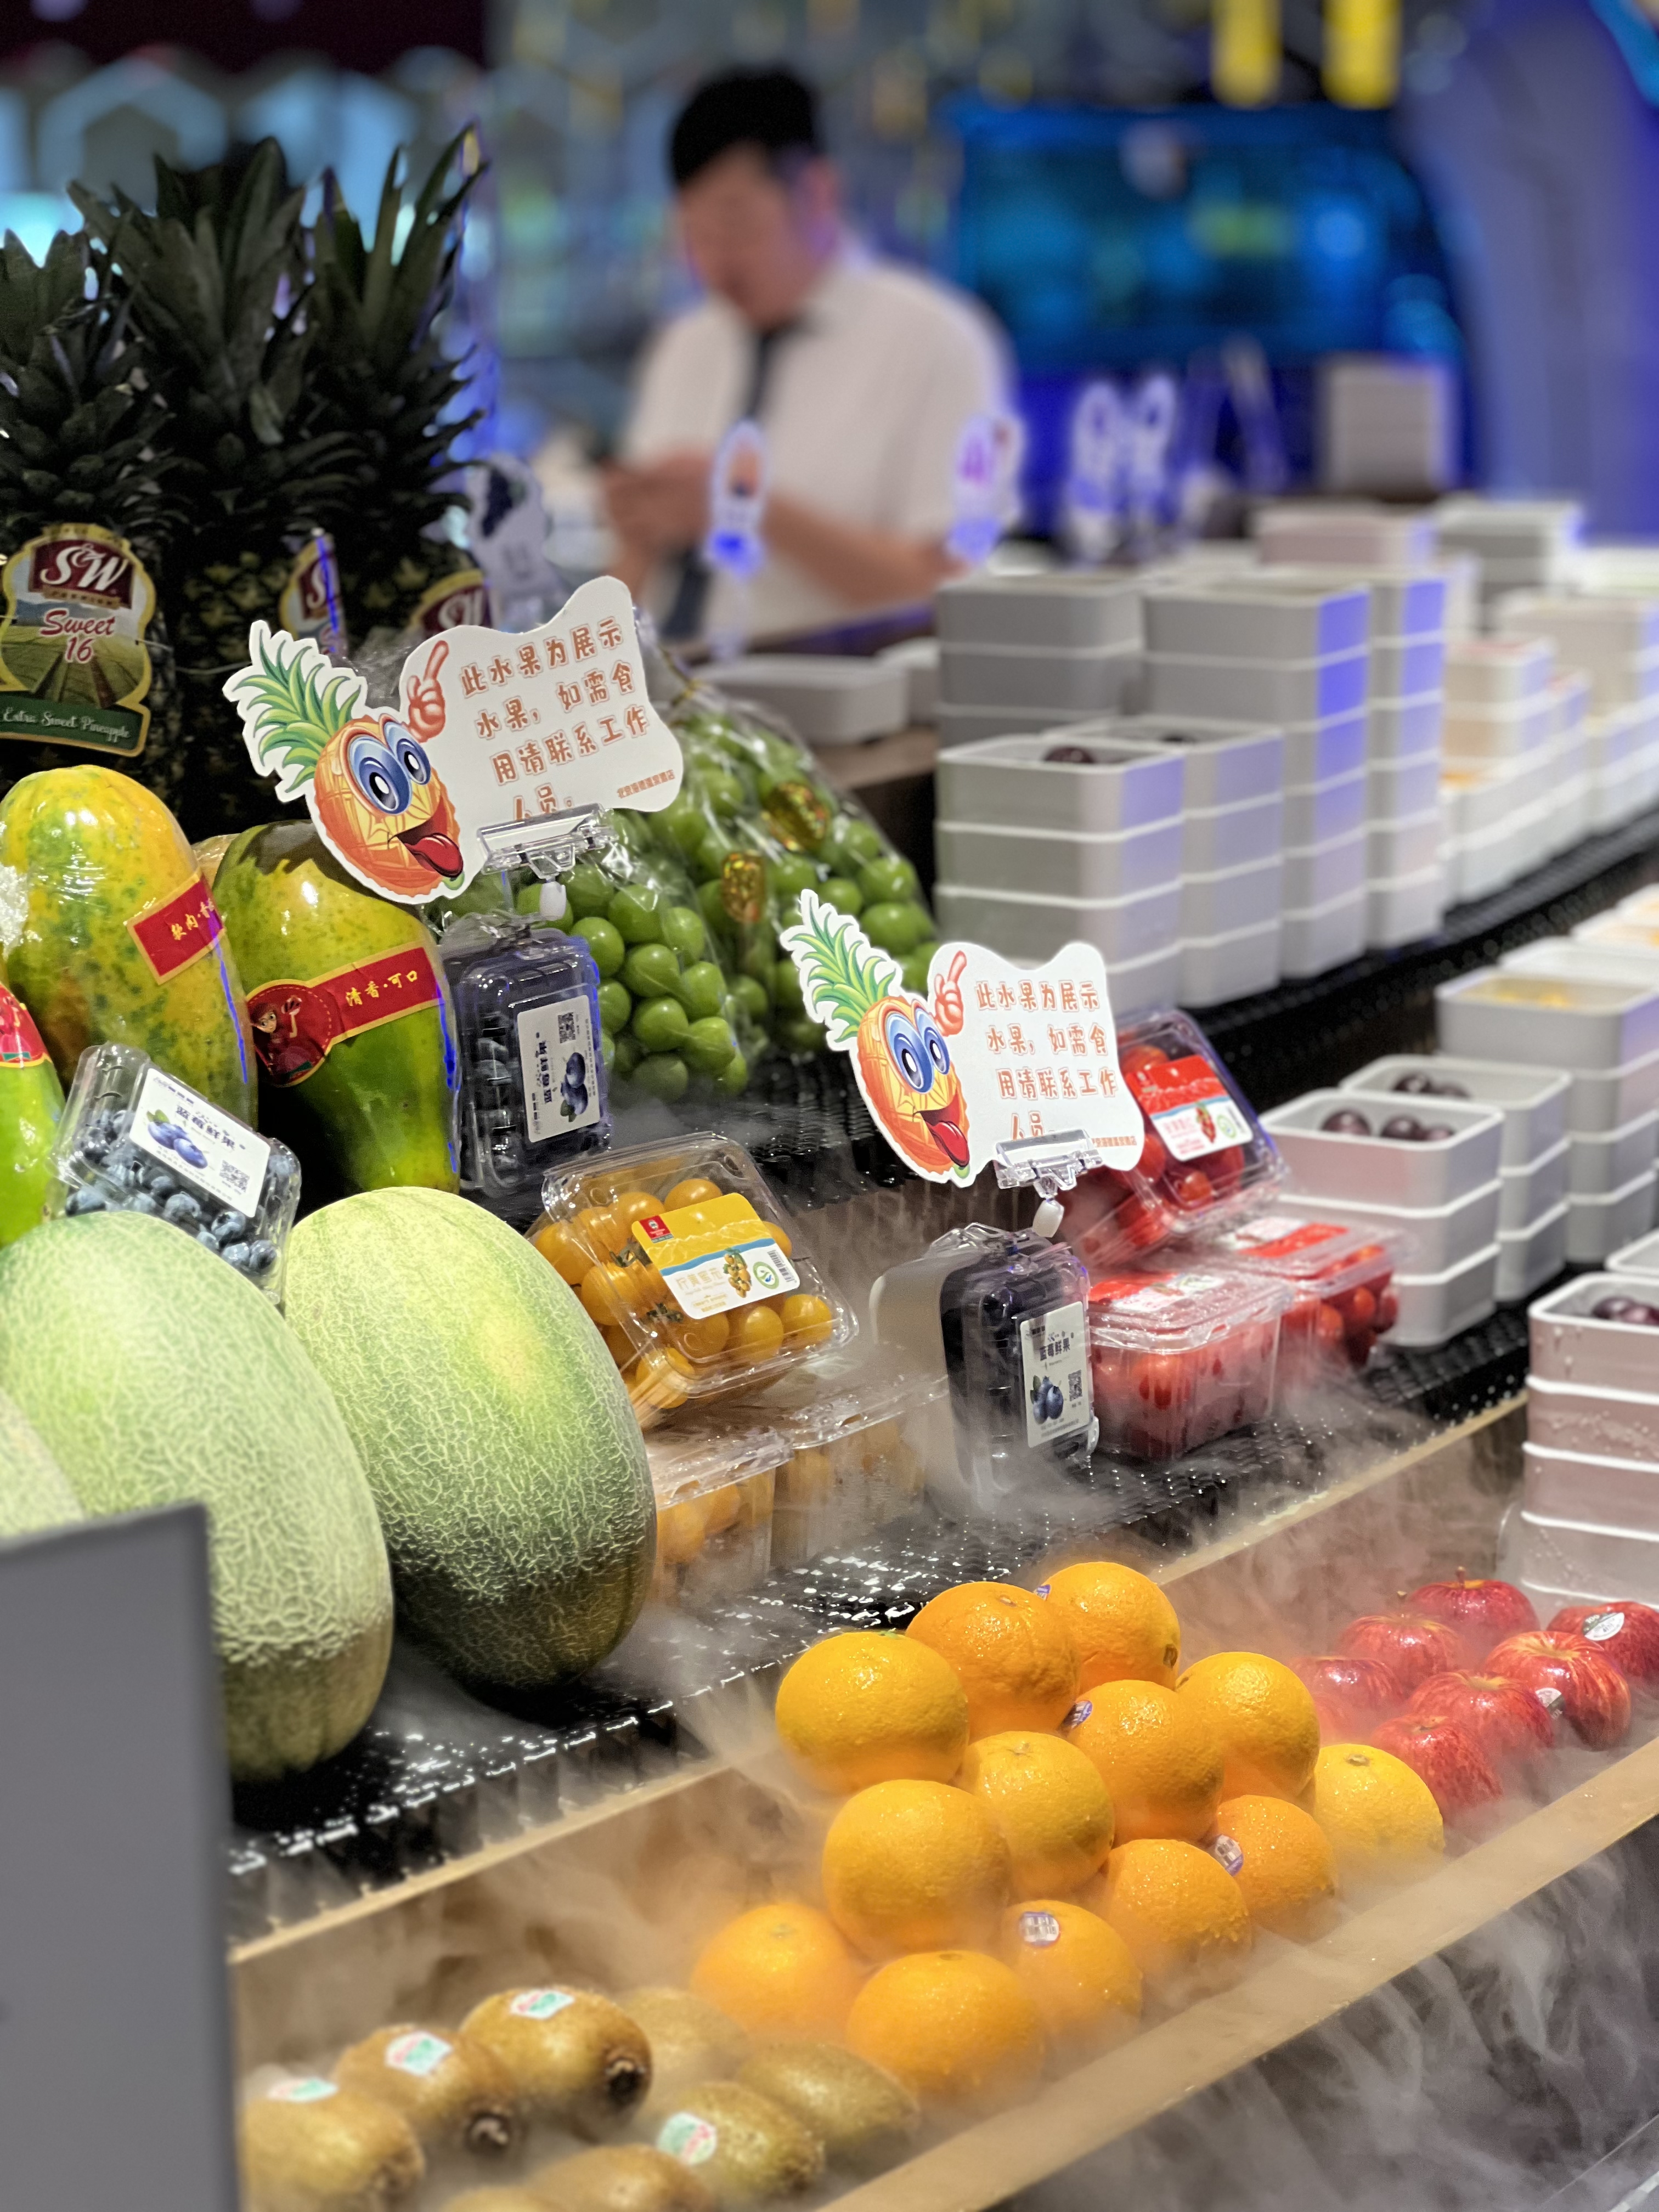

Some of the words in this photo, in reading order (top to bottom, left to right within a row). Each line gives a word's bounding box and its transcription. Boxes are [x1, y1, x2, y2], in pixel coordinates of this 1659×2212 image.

[40, 543, 129, 591] S&W
[40, 609, 116, 636] Sweet
[66, 636, 94, 662] 16
[461, 617, 623, 698] 此水果为展示
[492, 705, 649, 785] 用请联系工作
[976, 980, 1099, 1012] 此水果为展示
[996, 1067, 1118, 1099] 用请联系工作
[1011, 1110, 1057, 1140] 人员
